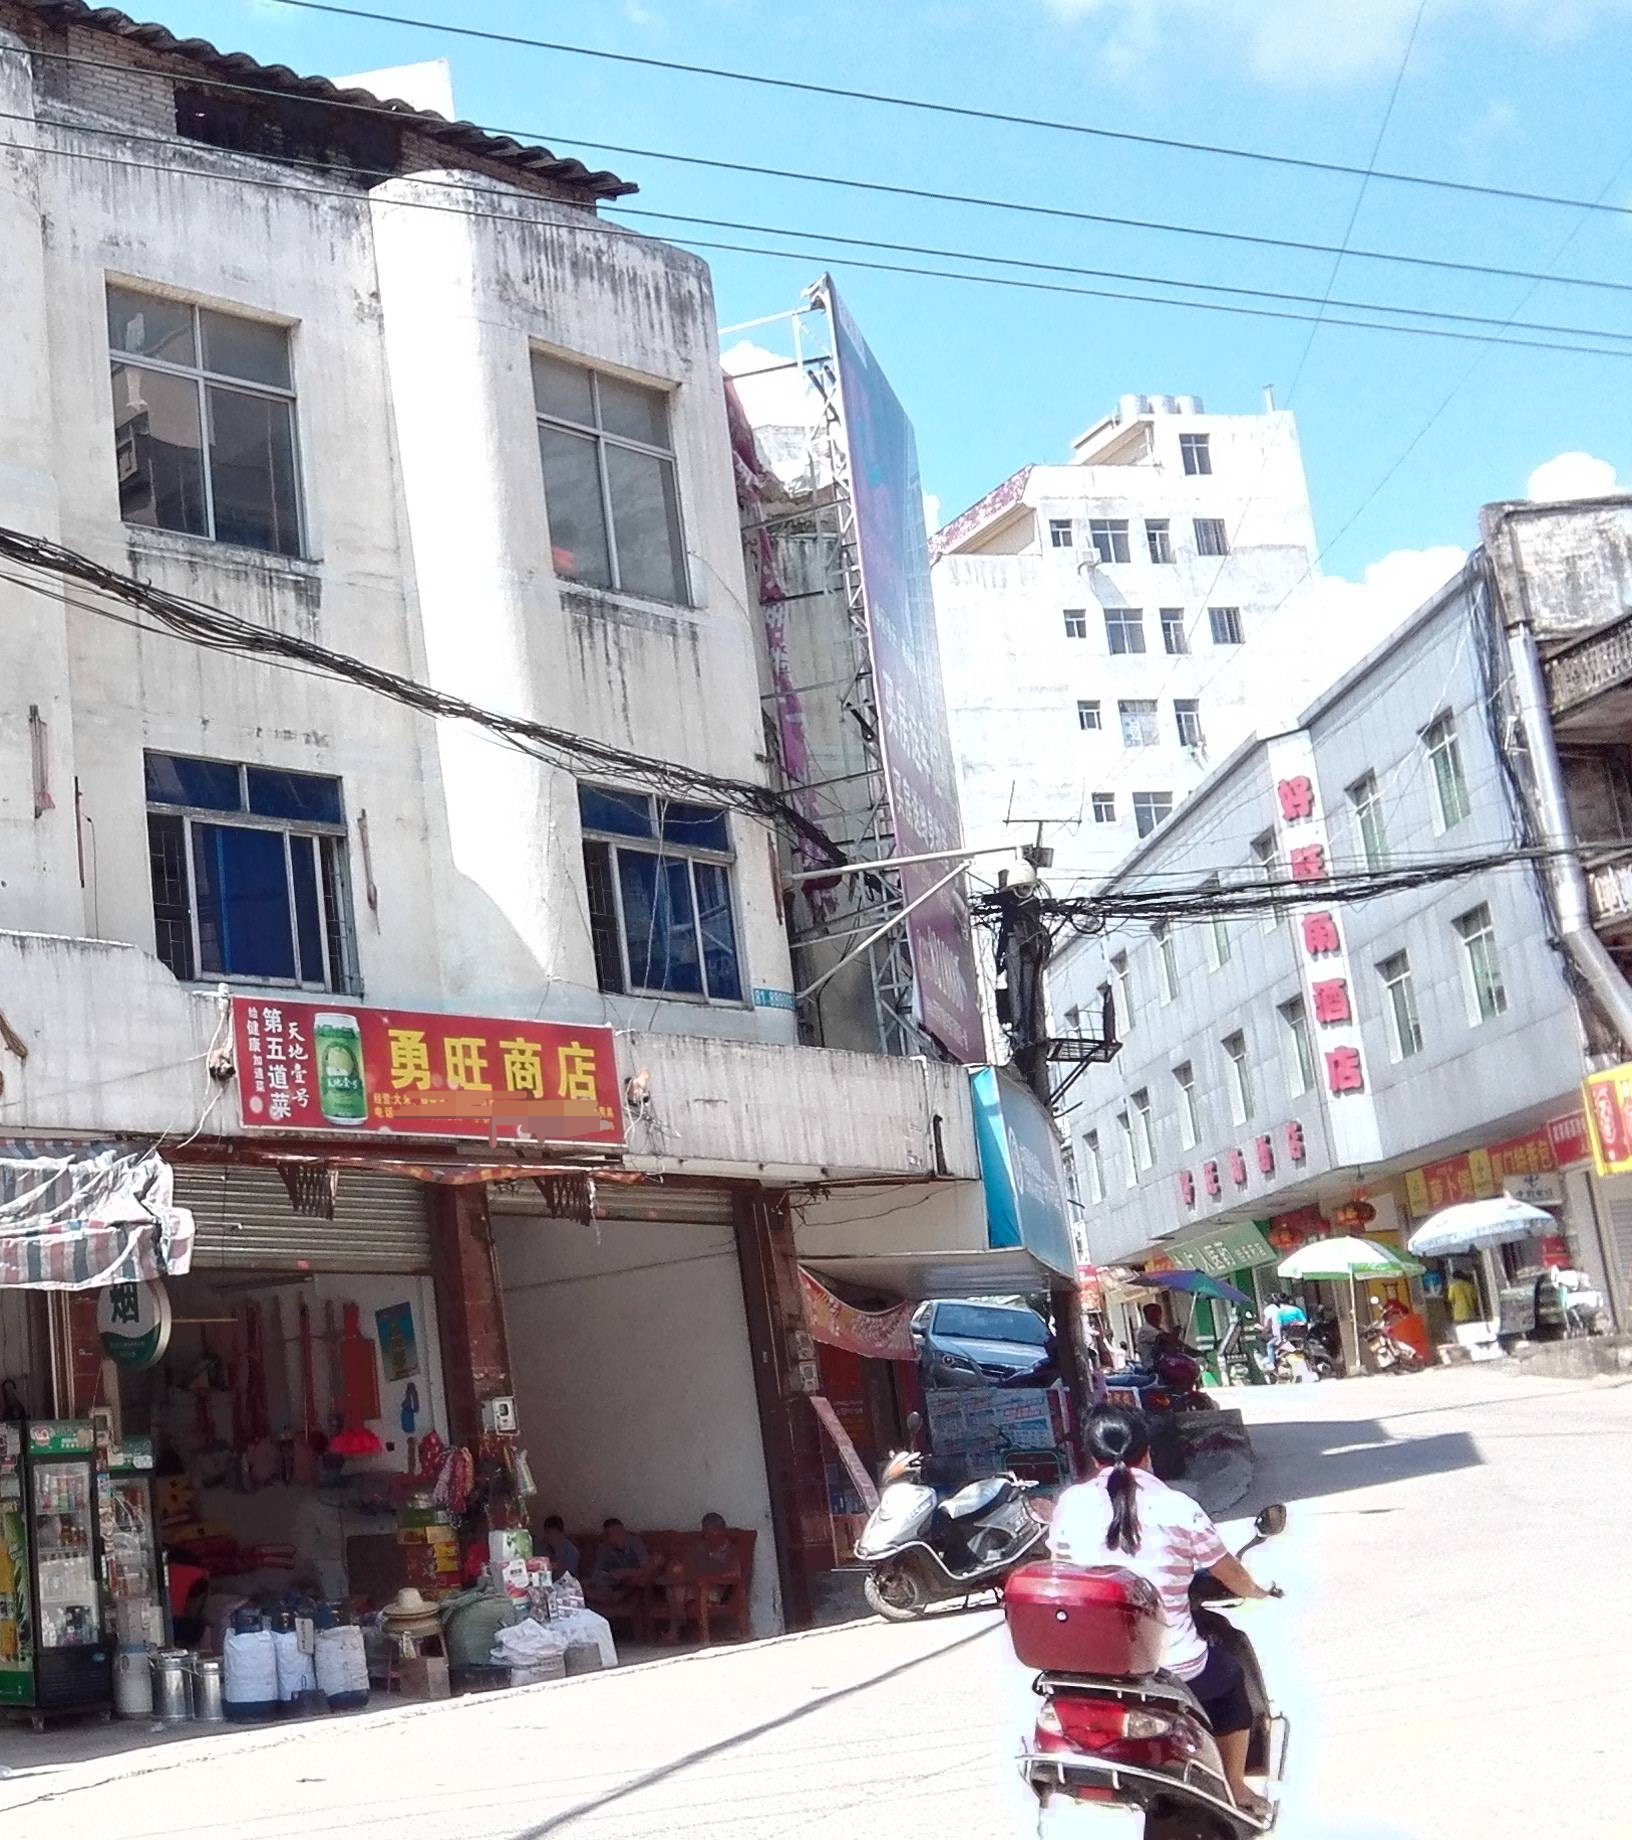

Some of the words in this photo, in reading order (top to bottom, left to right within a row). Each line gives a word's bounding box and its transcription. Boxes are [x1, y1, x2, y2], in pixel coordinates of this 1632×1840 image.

[263, 1007, 291, 1118] 第五道菜
[288, 1022, 309, 1108] 天地壹号
[388, 1028, 598, 1101] 勇旺商店
